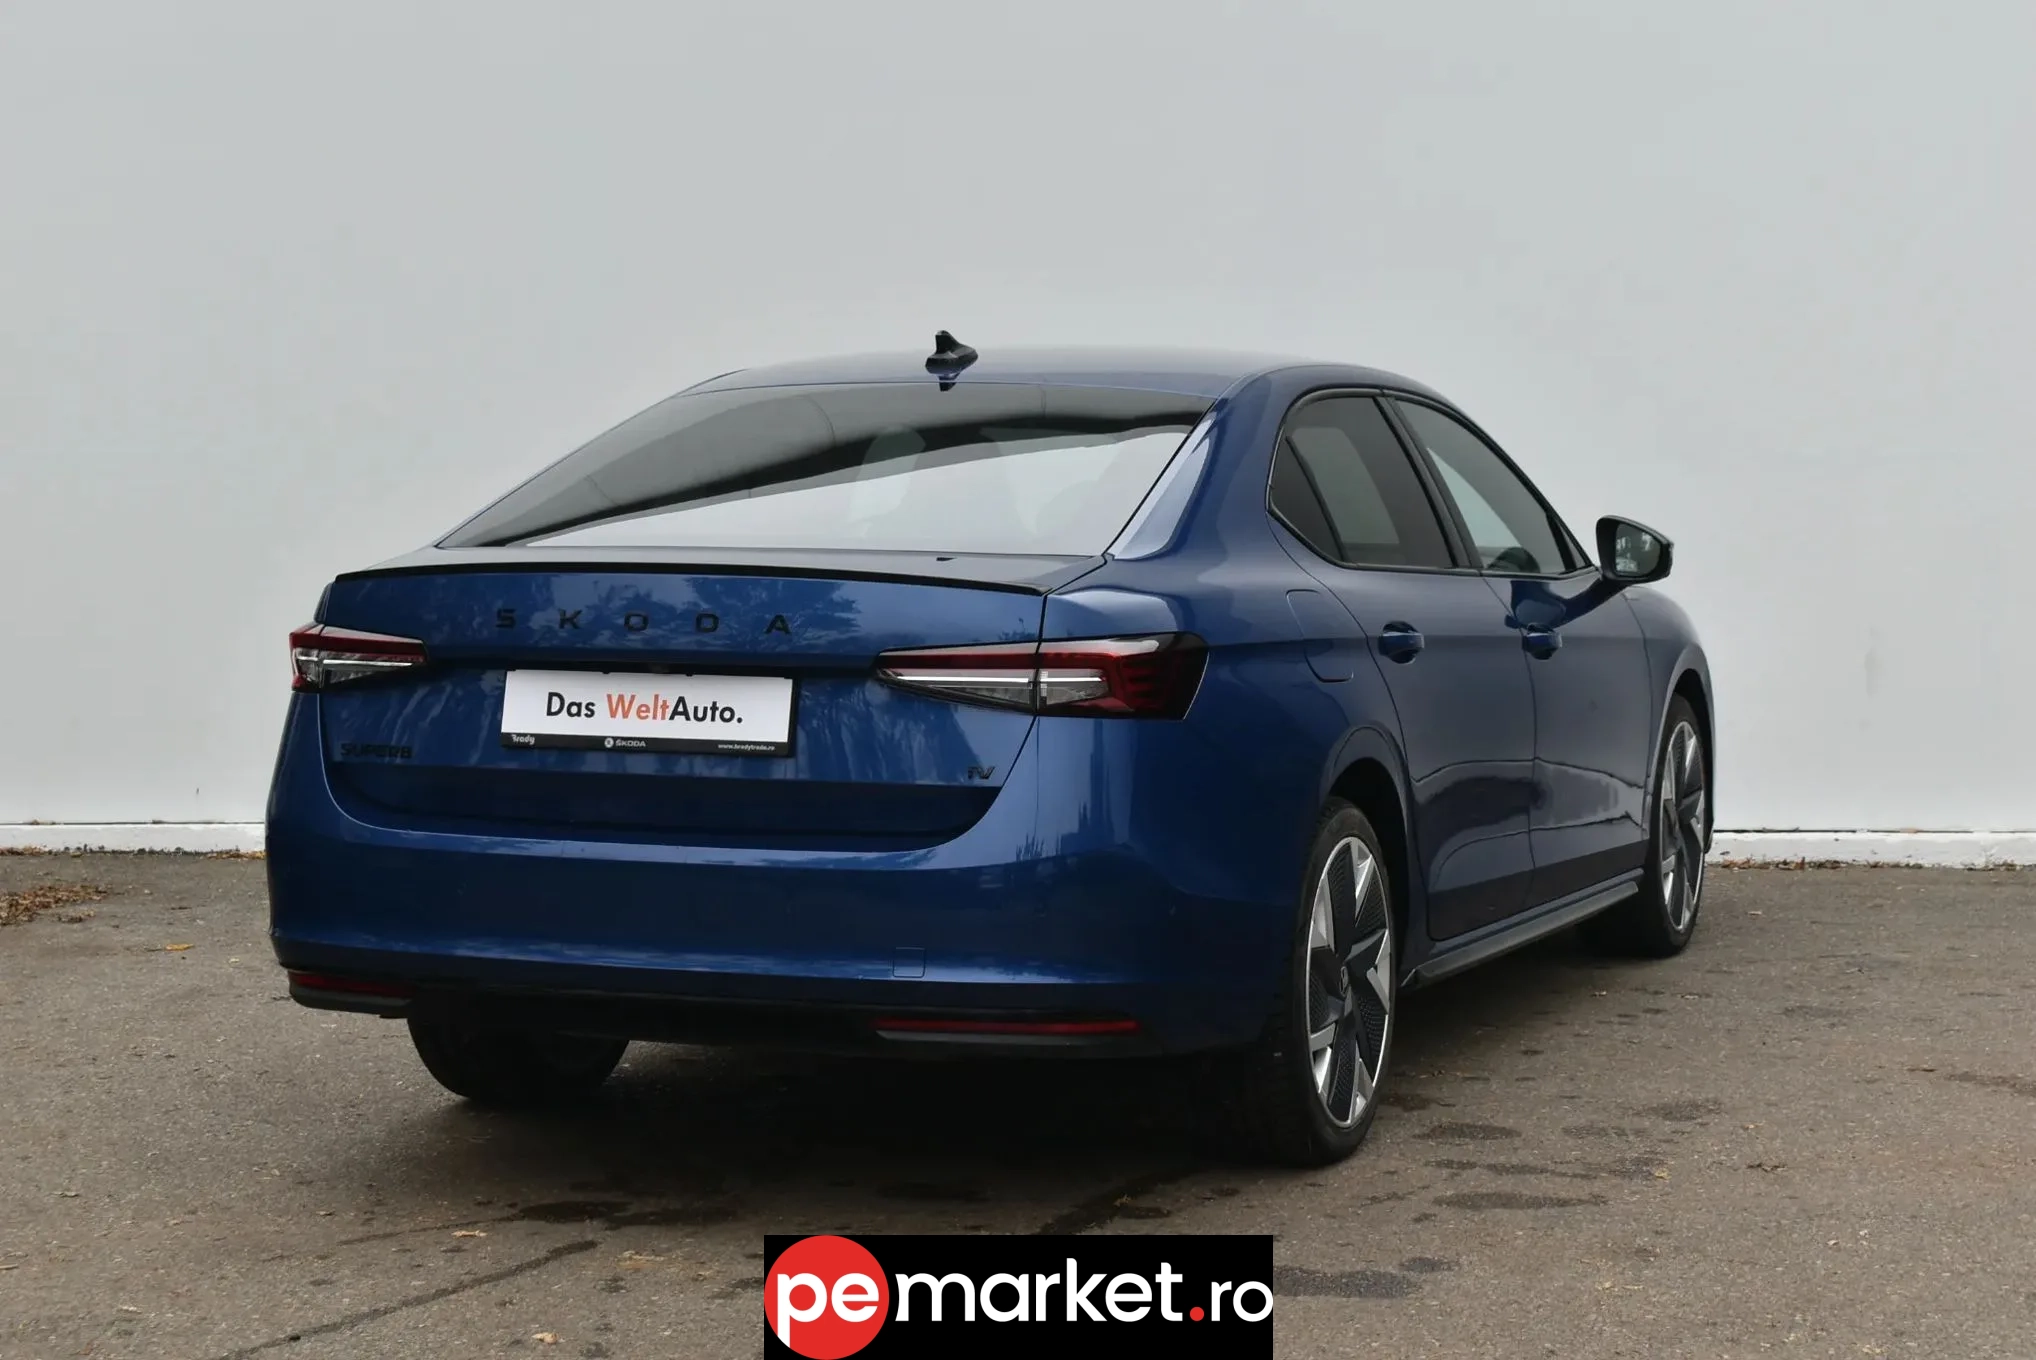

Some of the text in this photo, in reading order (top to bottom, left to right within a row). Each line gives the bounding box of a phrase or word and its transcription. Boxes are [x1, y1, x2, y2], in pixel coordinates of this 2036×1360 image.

[546, 692, 744, 724] Das WeltAuto.
[340, 743, 413, 758] SUPERB
